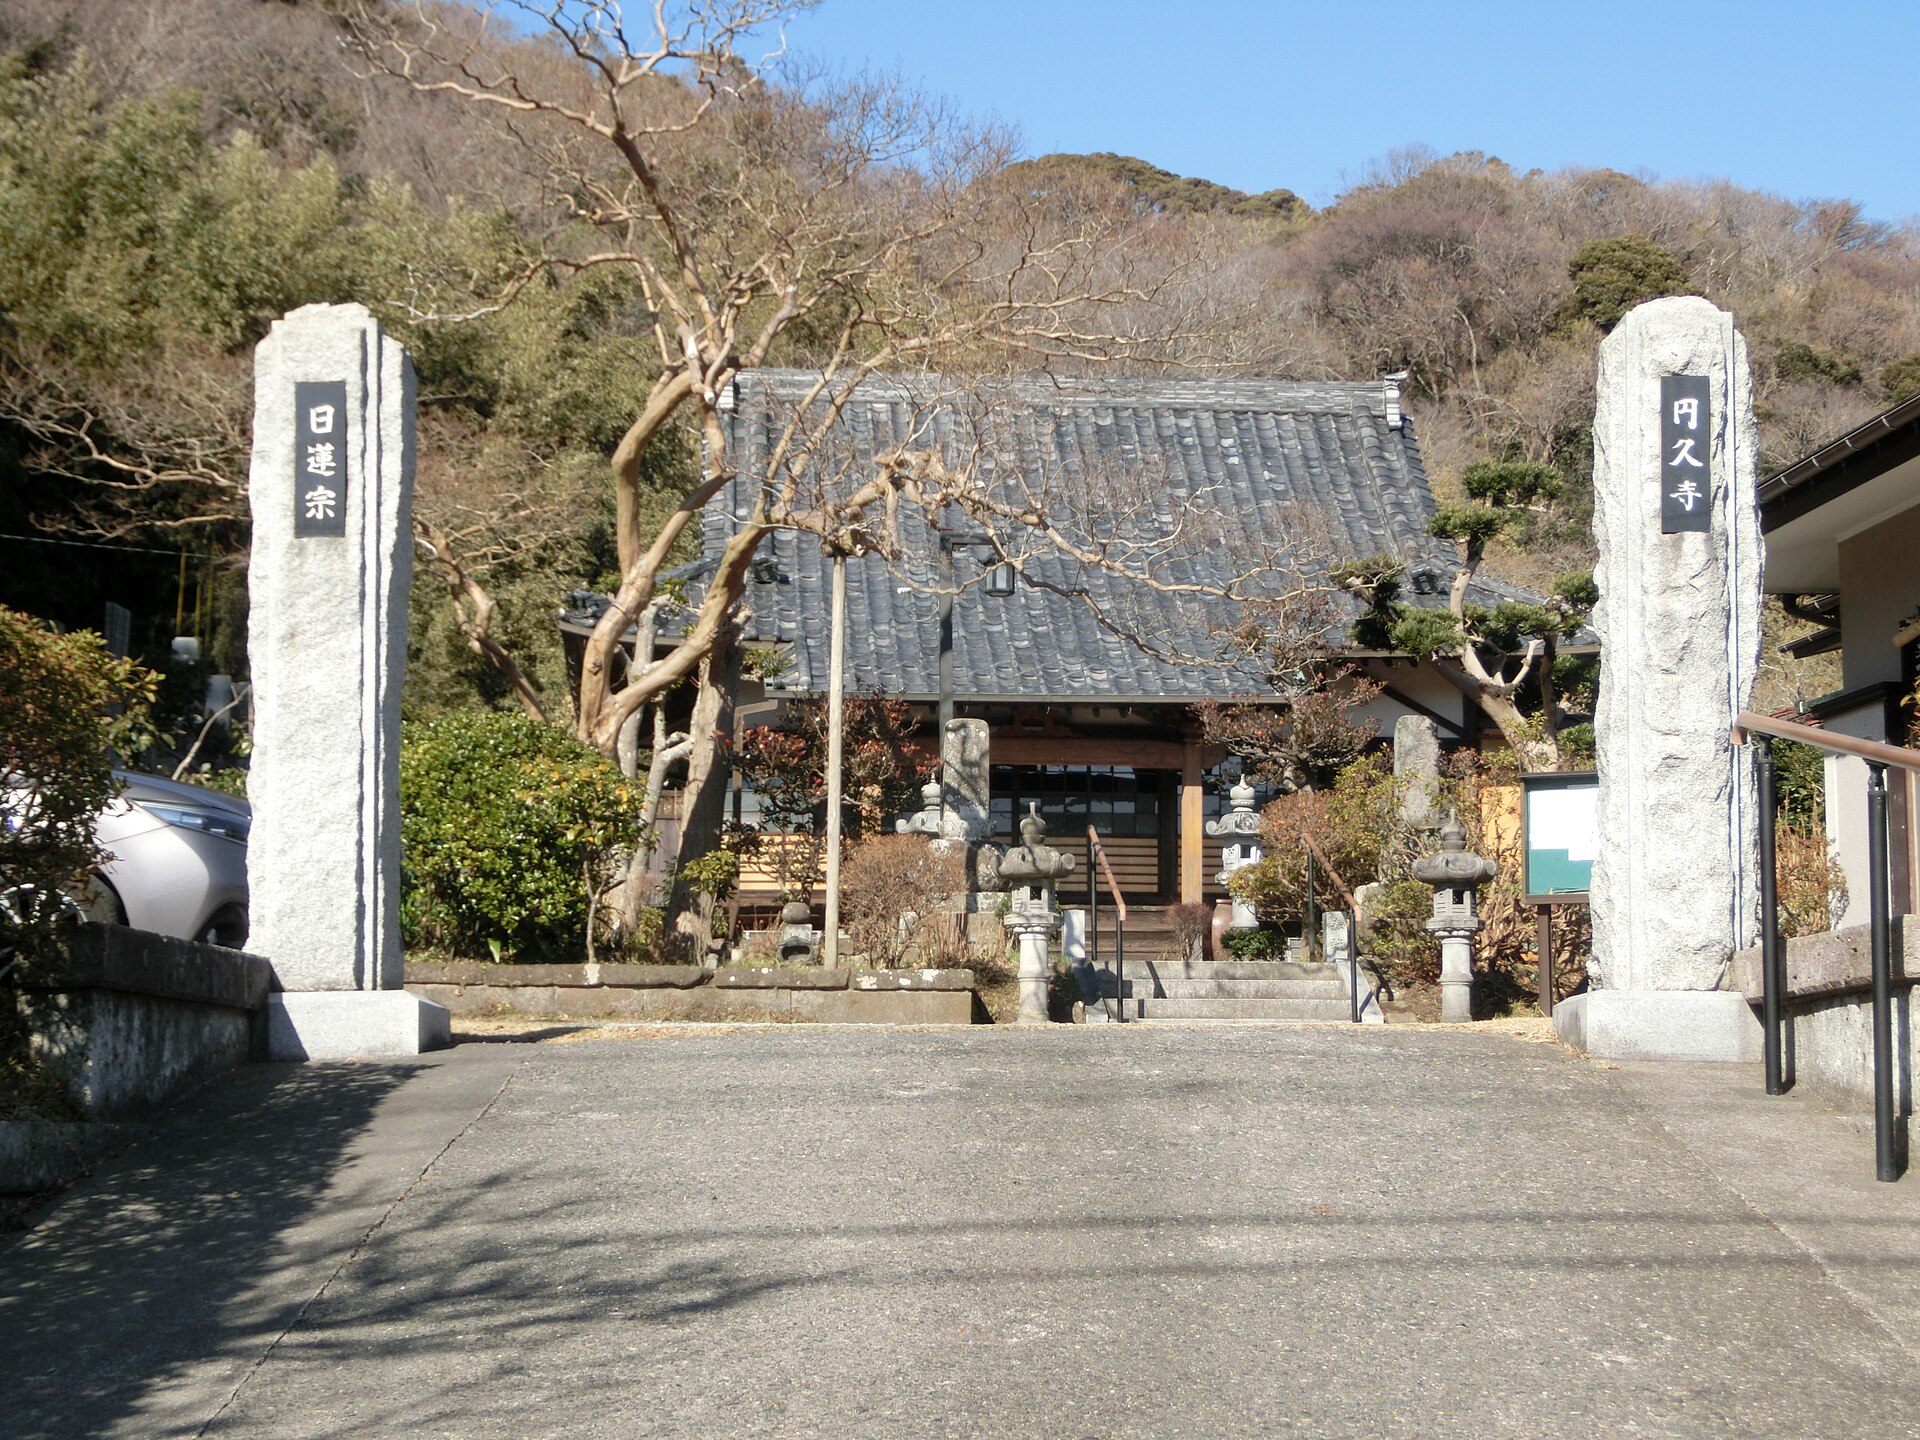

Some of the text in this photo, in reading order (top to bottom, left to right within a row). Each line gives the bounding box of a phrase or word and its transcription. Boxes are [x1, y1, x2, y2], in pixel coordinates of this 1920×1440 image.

[304, 404, 337, 520] 日蓮宗
[1668, 398, 1704, 512] 円久寺
